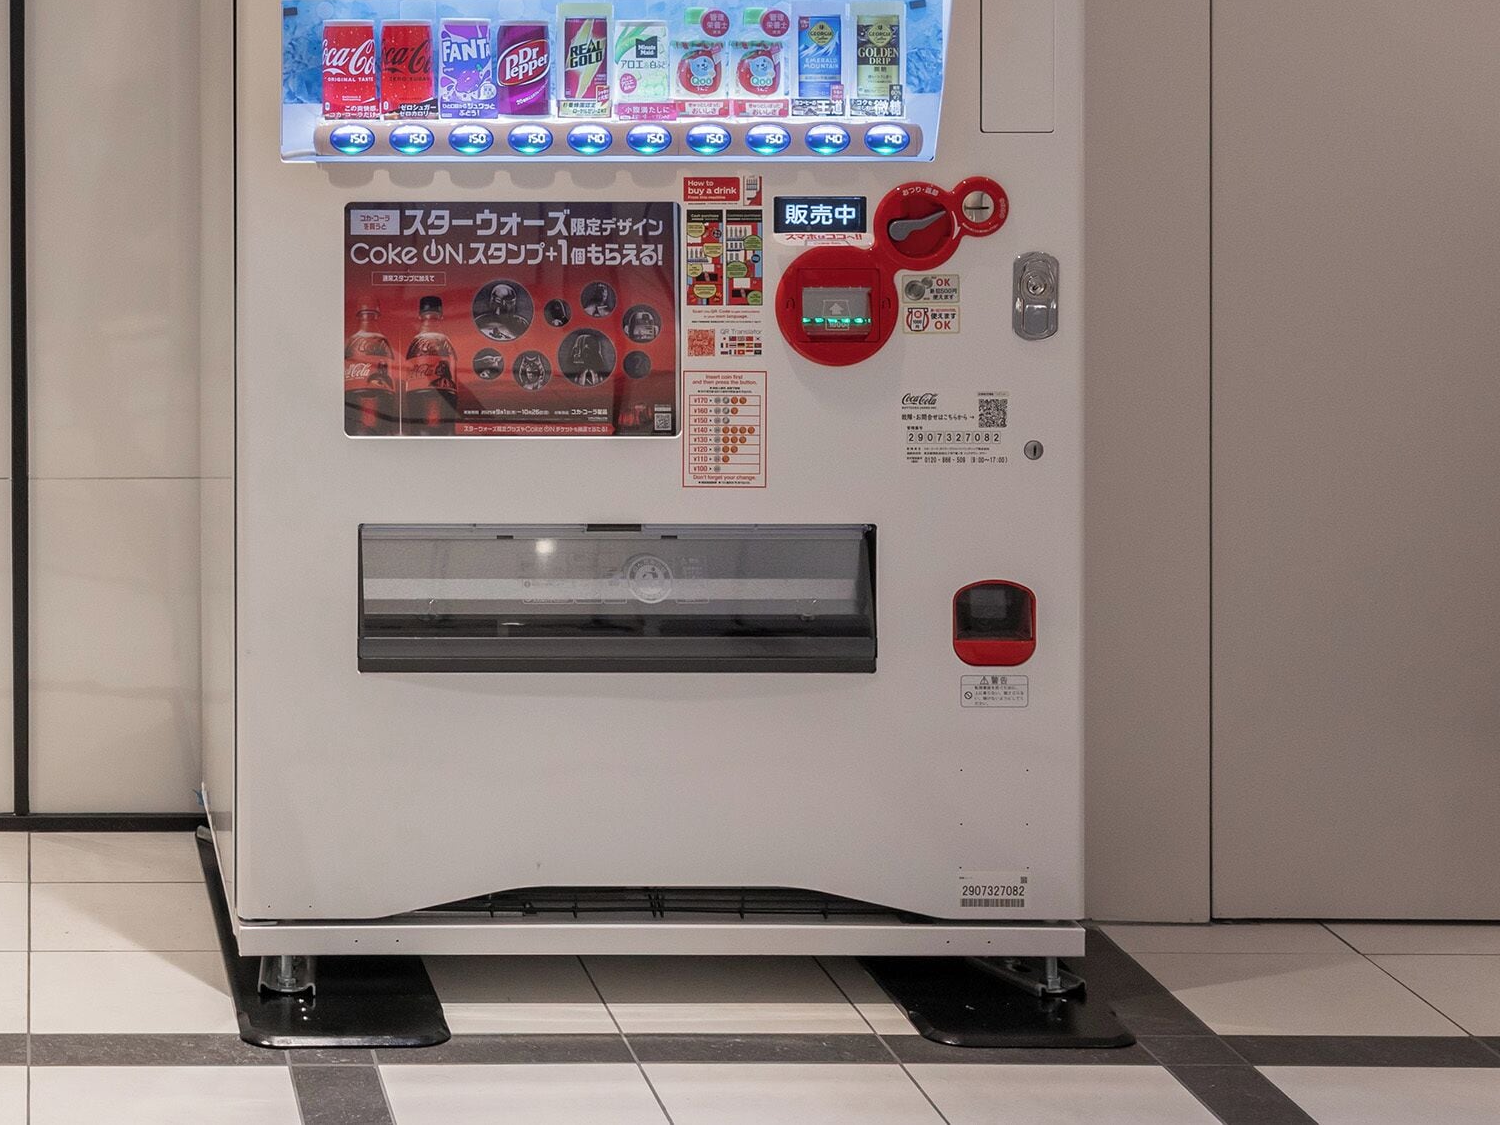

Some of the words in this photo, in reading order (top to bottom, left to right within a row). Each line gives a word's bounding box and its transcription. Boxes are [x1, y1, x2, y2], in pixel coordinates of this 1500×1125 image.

[570, 40, 602, 57] REAL
[858, 47, 899, 58] GOLDEN
[518, 47, 539, 62] Dr
[570, 51, 603, 69] GOLD
[505, 53, 548, 80] Pepper
[691, 77, 712, 86] Qoo
[751, 77, 772, 86] Qoo
[817, 100, 843, 115] 王道
[874, 99, 901, 115] 微糖
[350, 133, 368, 144] 150
[409, 133, 427, 144] 150
[469, 133, 487, 144] 150
[528, 133, 546, 144] 150
[588, 133, 606, 144] 140
[647, 133, 665, 144] 150
[707, 133, 725, 144] 150
[766, 133, 784, 144] 150
[826, 133, 844, 144] 140
[885, 133, 903, 144] 140
[688, 187, 705, 195] buy
[785, 204, 857, 225] 販売中
[350, 243, 418, 265] Coke
[936, 278, 950, 286] OK
[935, 320, 951, 330] OK
[908, 433, 1000, 442] 2907327082
[962, 885, 1025, 896] 2907327082
